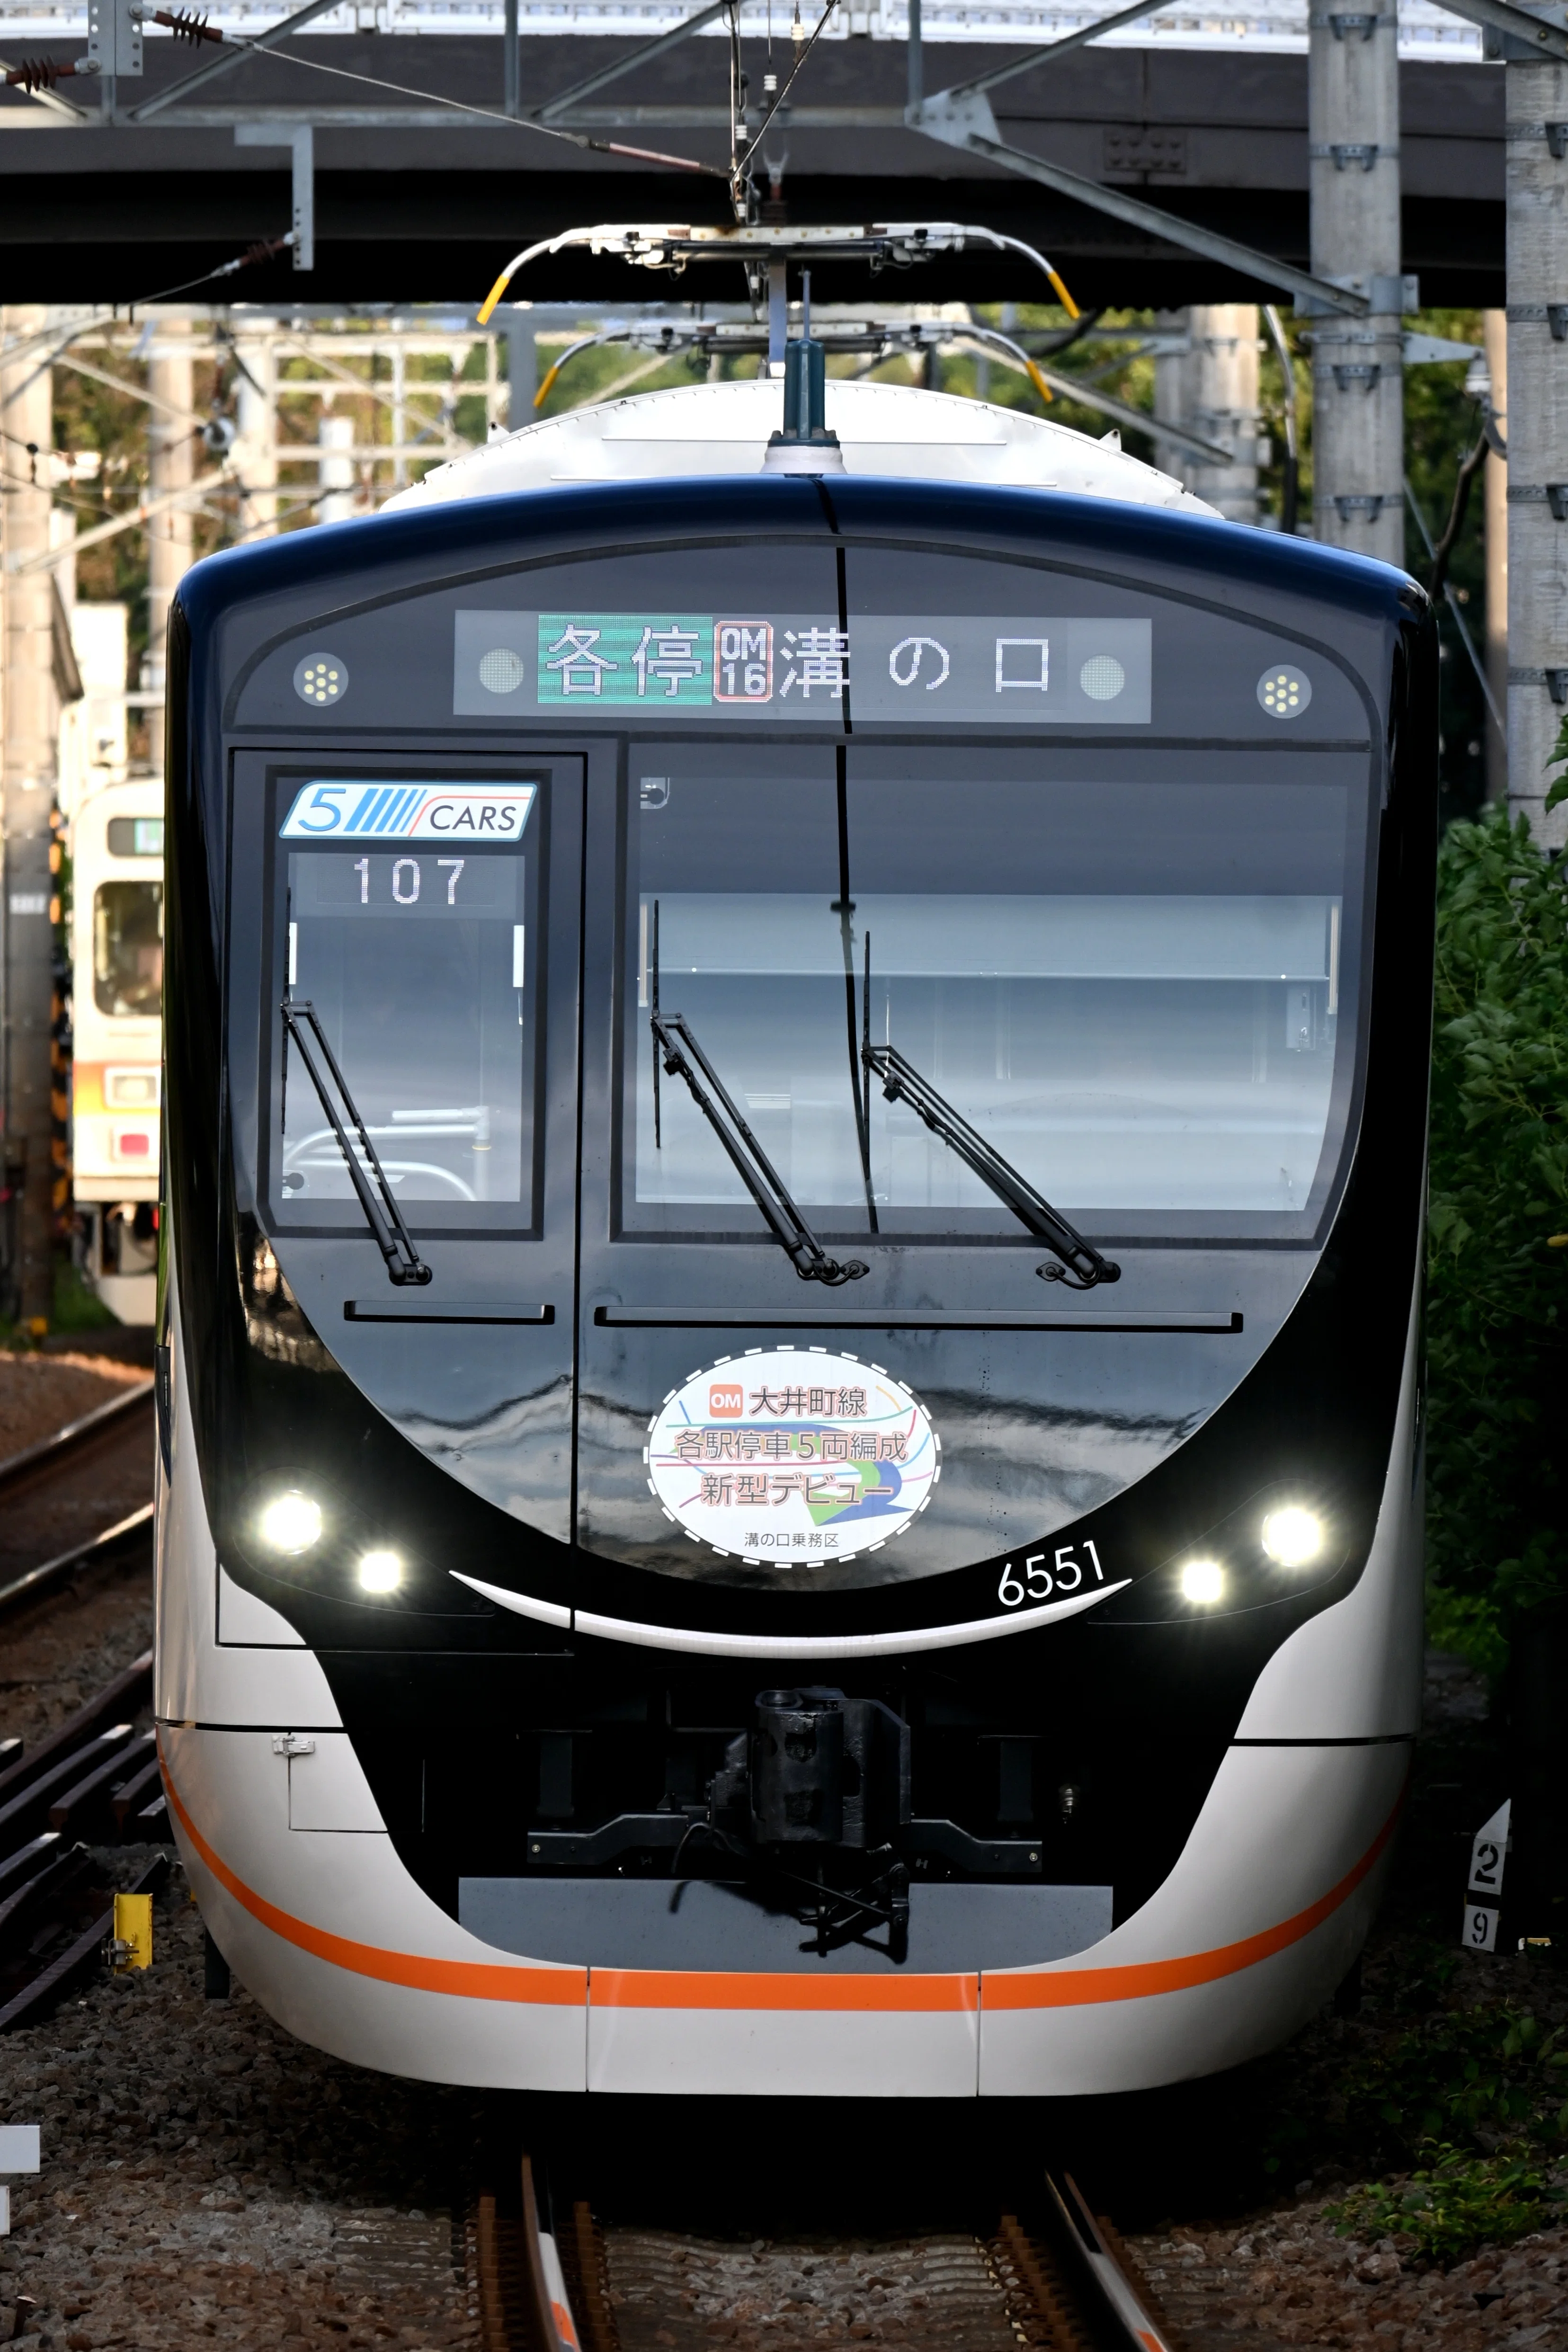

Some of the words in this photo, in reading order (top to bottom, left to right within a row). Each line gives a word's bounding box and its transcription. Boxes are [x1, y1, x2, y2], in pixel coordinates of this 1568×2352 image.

[546, 624, 703, 696] 各停
[720, 628, 767, 660] OM
[722, 663, 766, 695] 16
[779, 627, 1049, 698] 溝の口
[297, 788, 347, 832] 5
[429, 804, 517, 831] CARS
[354, 858, 465, 905] 107
[710, 1393, 741, 1409] OM
[749, 1386, 867, 1416] 大井町線
[675, 1430, 908, 1461] 各駅停車5両編成
[701, 1473, 893, 1506] 新型デビュー
[744, 1532, 839, 1548] 溝の口乗務区
[998, 1540, 1105, 1606] 6551
[1474, 1843, 1499, 1885] 2
[1471, 1912, 1488, 1944] 9
